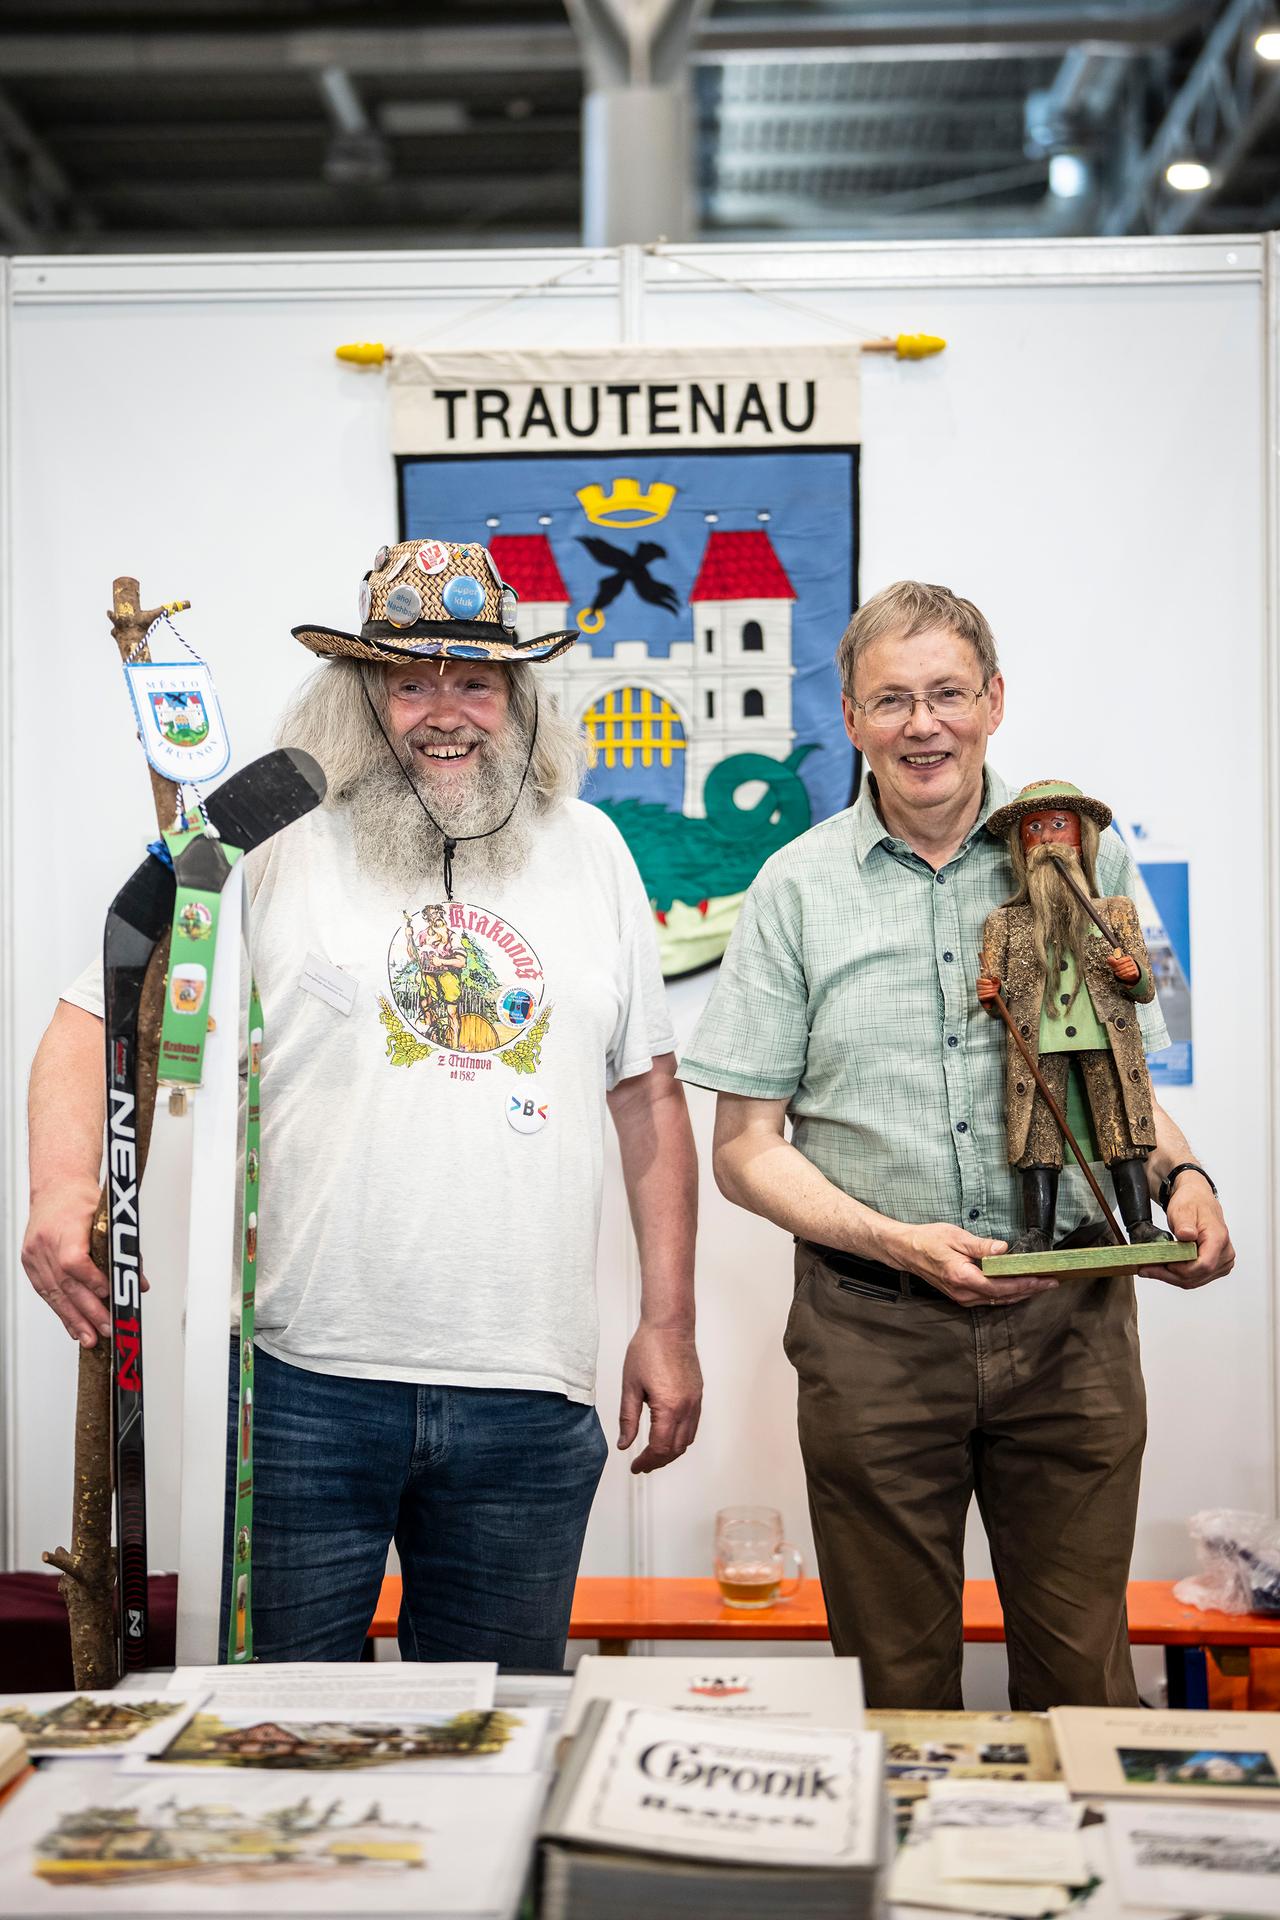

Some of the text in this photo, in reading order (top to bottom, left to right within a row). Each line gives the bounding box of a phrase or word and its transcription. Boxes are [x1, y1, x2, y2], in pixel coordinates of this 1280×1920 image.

[433, 381, 817, 439] TRAUTENAU
[449, 903, 545, 981] Krakonoš
[448, 1054, 492, 1071] Trutnova
[459, 1070, 476, 1082] 1582
[109, 1089, 140, 1309] NEXUS
